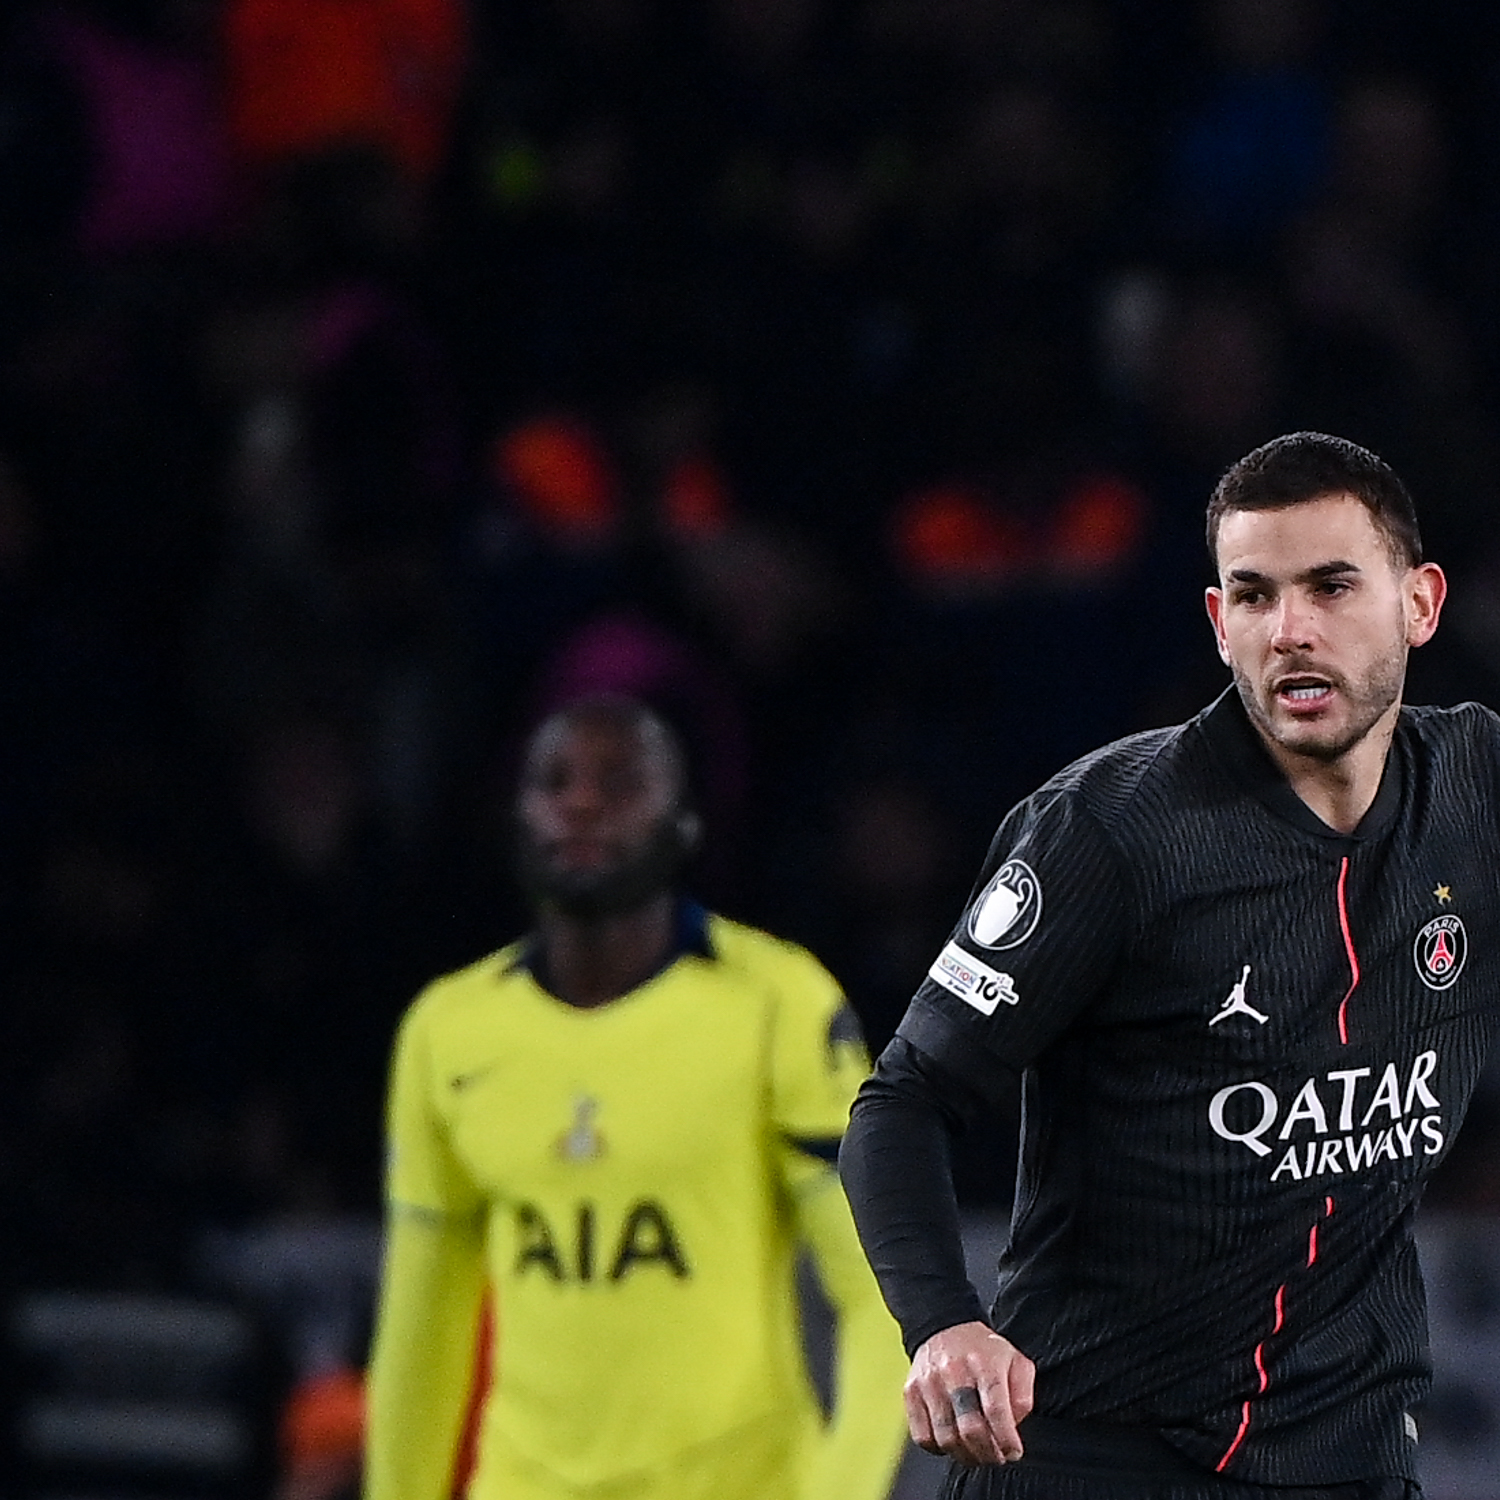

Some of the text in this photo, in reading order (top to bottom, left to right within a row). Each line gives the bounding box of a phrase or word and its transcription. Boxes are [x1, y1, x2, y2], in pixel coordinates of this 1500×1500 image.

[1424, 918, 1459, 938] PARIS
[1208, 1050, 1441, 1157] QATAR
[1270, 1115, 1443, 1182] AIRWAYS
[512, 1200, 692, 1282] AIA
